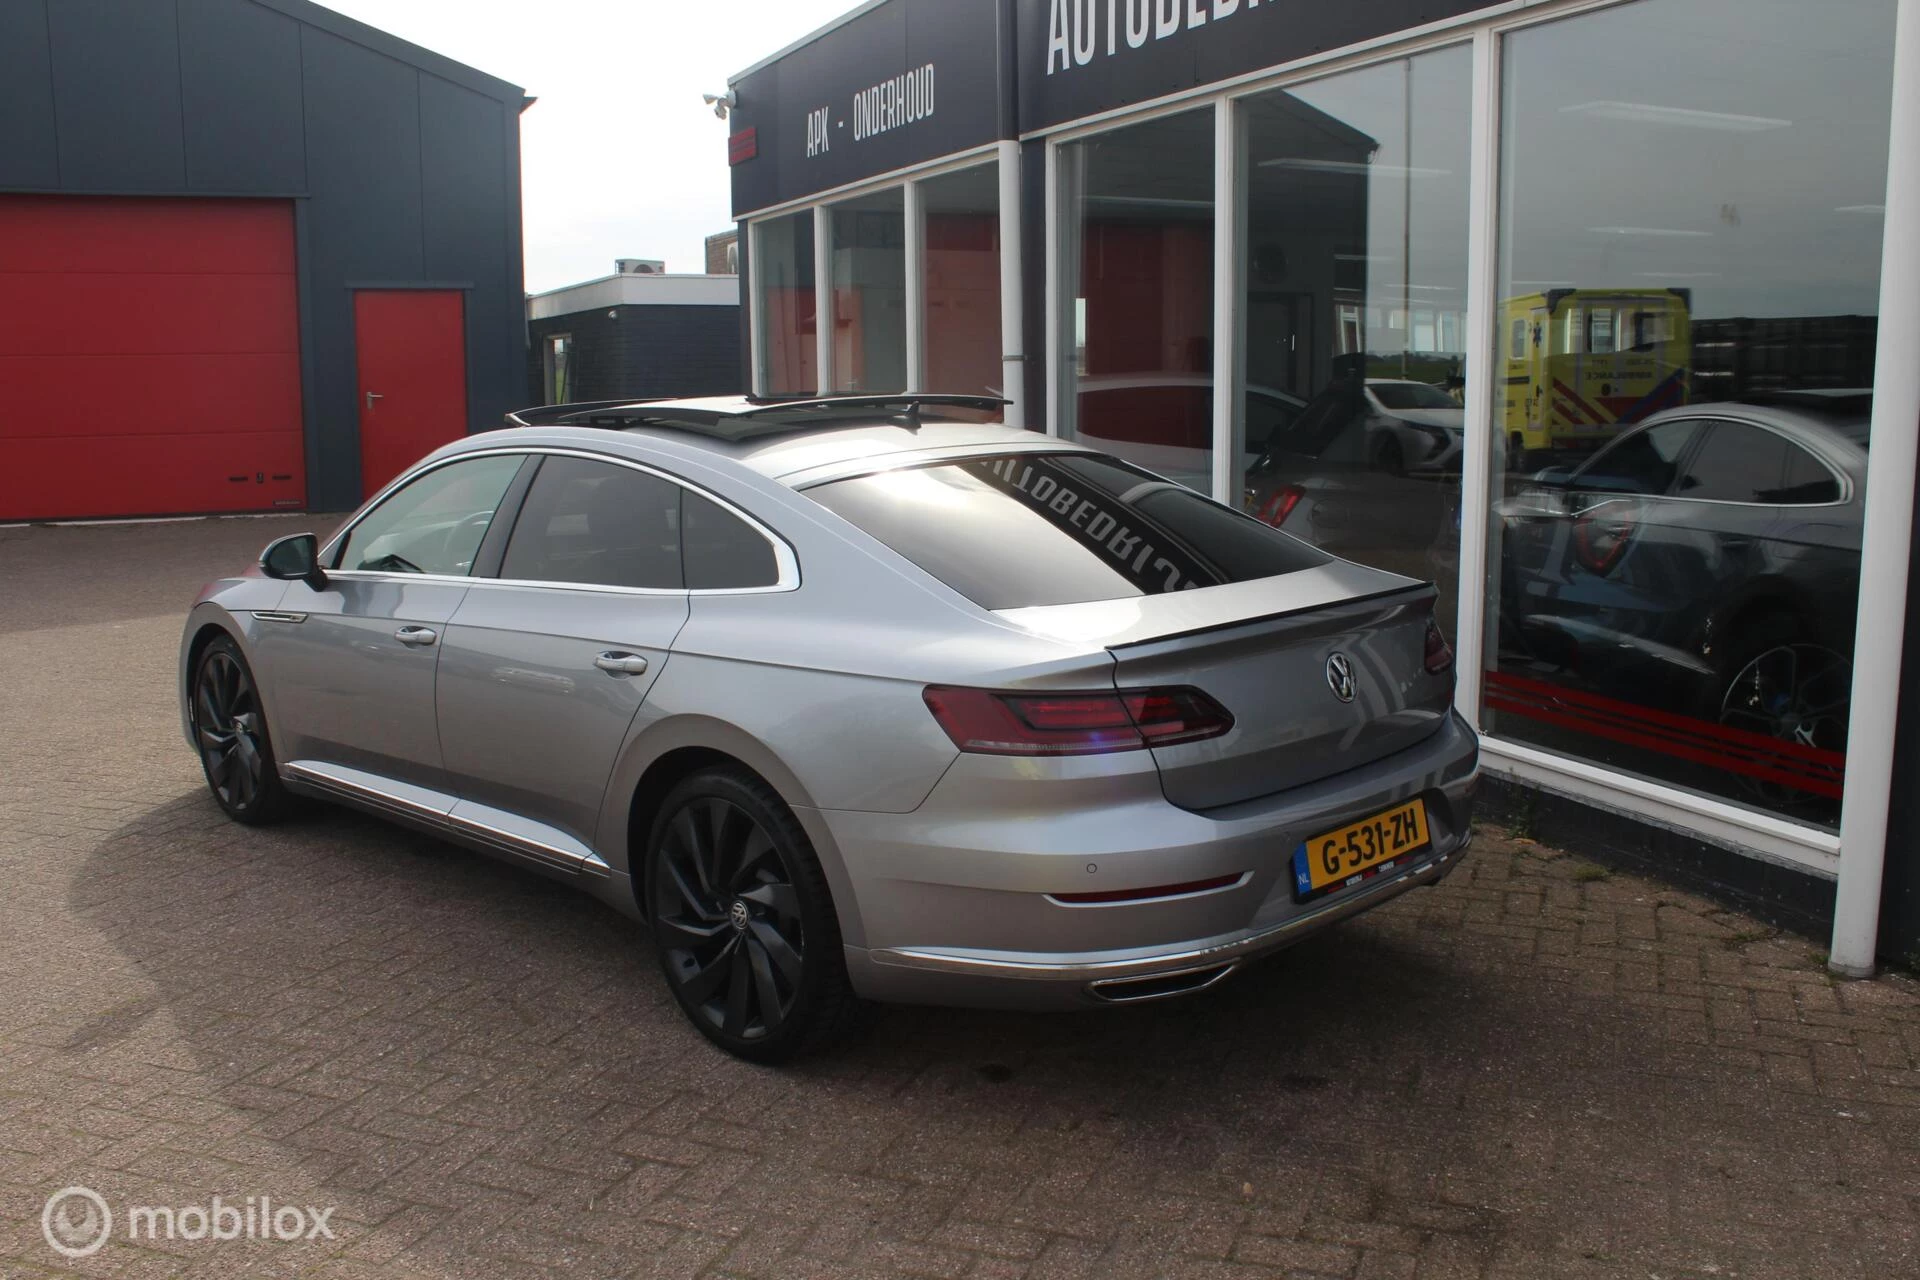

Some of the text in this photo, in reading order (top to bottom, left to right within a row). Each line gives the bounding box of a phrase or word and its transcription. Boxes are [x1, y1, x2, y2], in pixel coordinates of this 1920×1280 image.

[807, 106, 829, 157] APK
[854, 64, 935, 141] ONDERHOUD
[1322, 808, 1418, 874] G-531-ZH
[1297, 874, 1310, 886] NL
